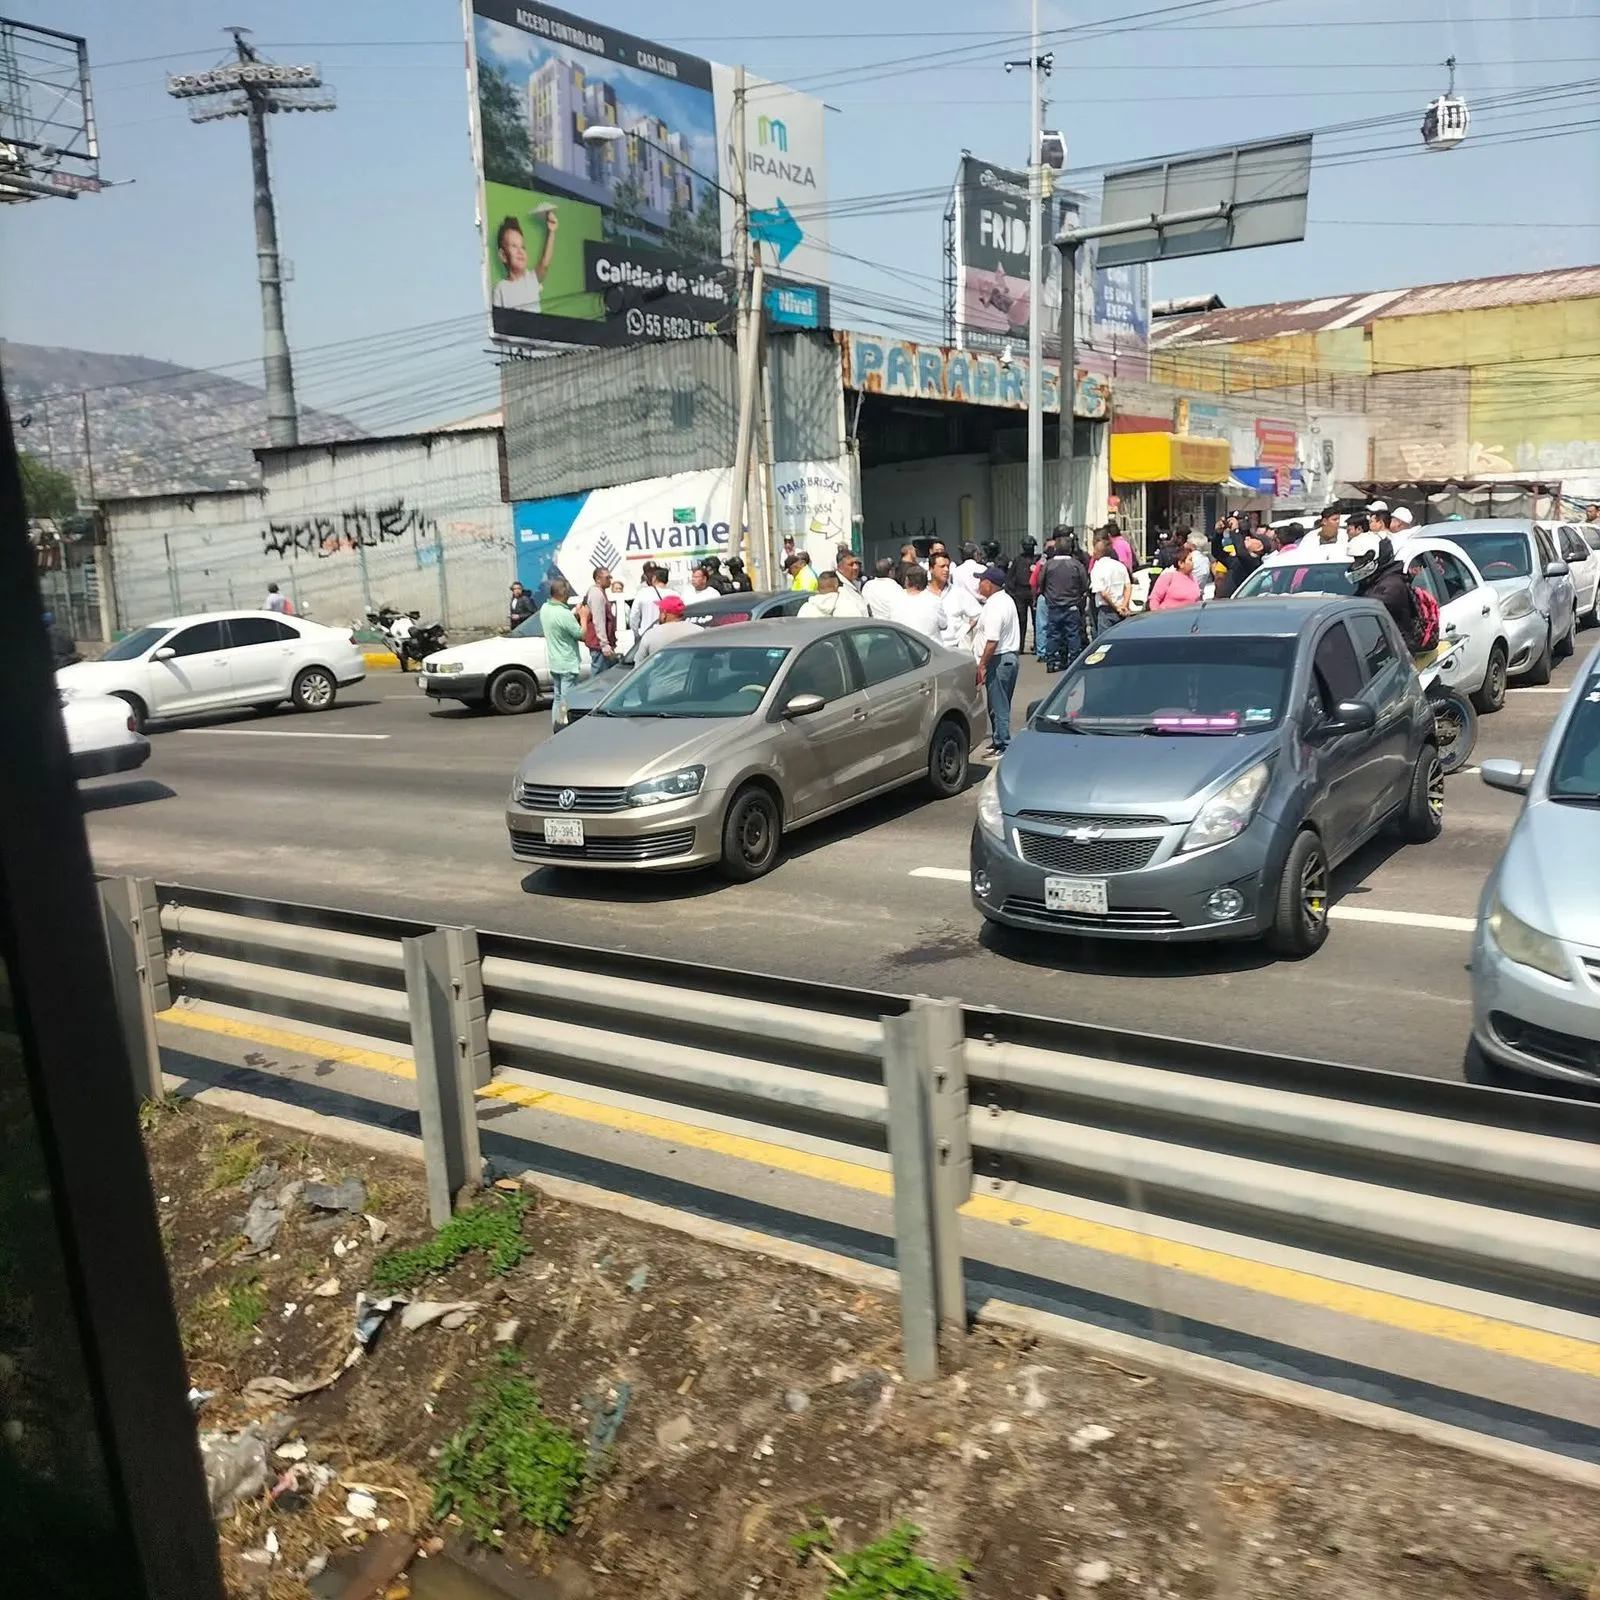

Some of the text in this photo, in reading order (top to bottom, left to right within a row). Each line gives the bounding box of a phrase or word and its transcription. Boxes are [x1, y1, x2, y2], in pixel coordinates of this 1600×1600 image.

[516, 8, 678, 77] ACCESO CONTROLADO CASA CLUB
[596, 258, 663, 289] Calidad
[666, 271, 687, 294] de
[645, 313, 661, 336] 55
[777, 476, 843, 500] PARABRISAS
